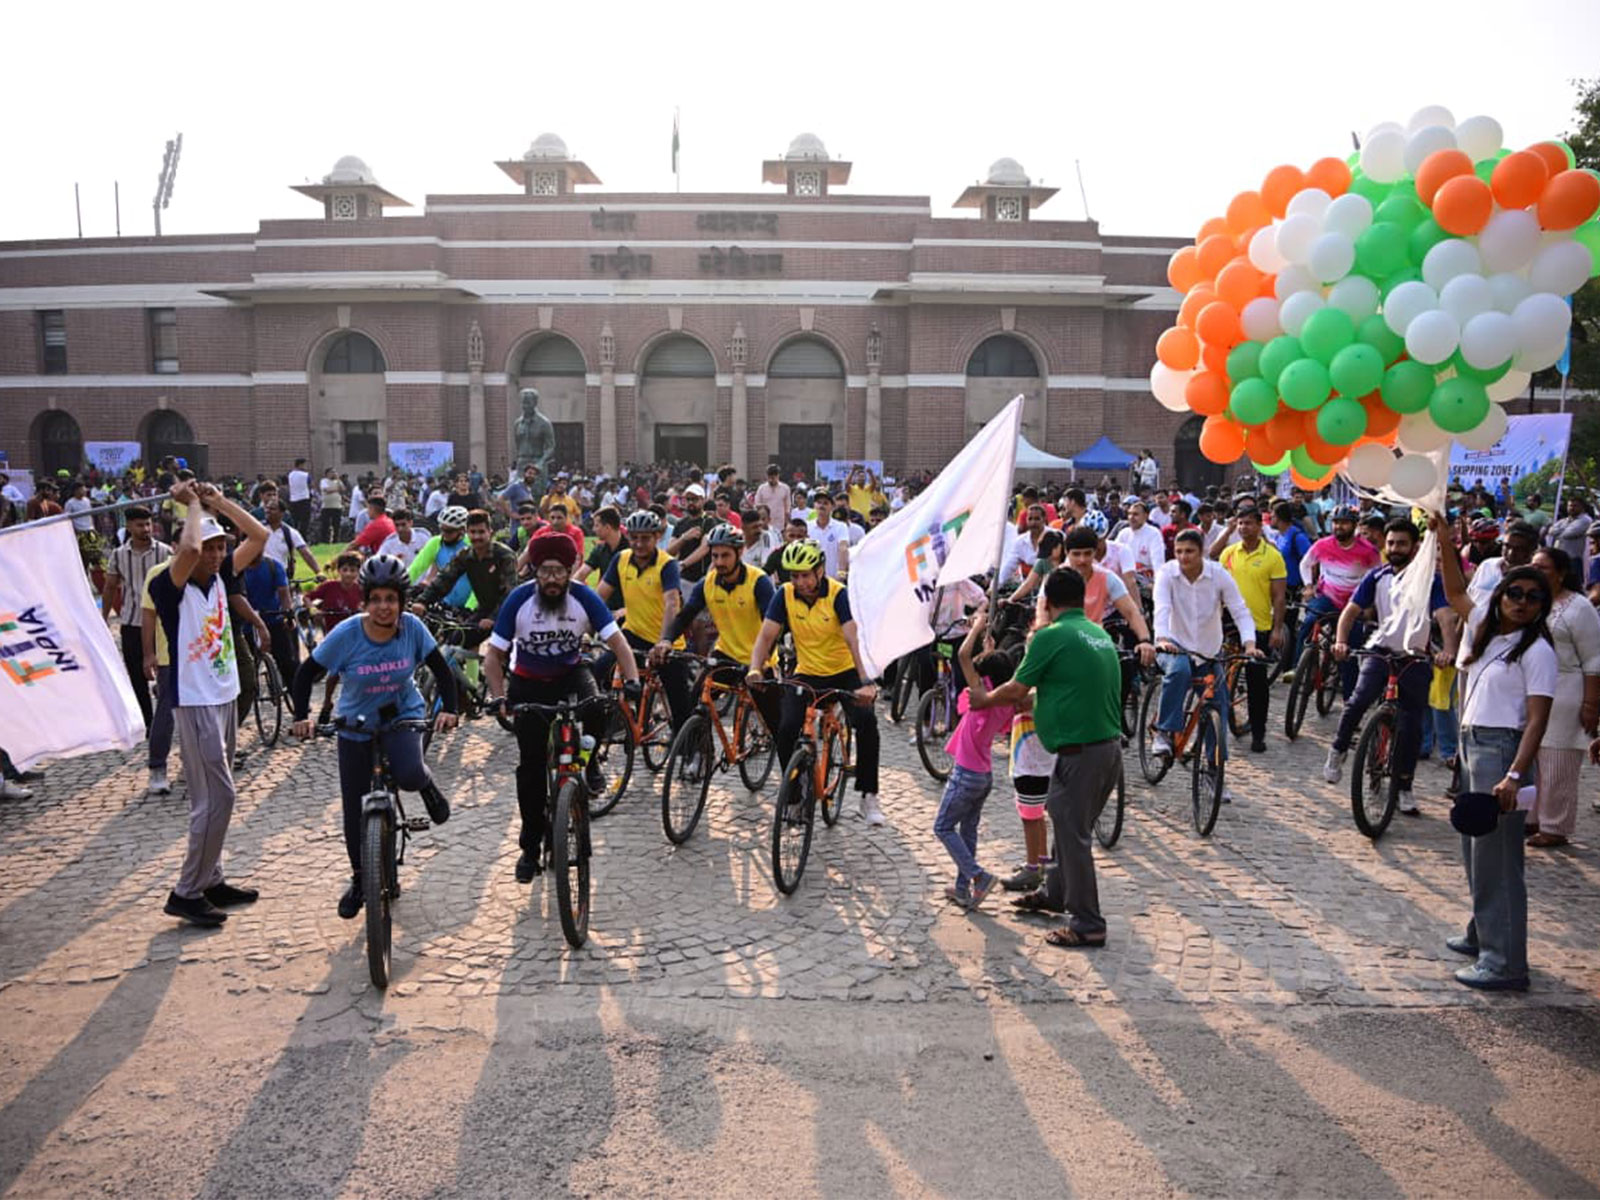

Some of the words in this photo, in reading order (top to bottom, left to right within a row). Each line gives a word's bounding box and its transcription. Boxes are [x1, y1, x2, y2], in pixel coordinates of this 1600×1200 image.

[1452, 464, 1488, 476] SKIPPING
[1490, 464, 1513, 476] ZONE
[17, 607, 79, 672] INDIA
[529, 629, 576, 643] STRAVA
